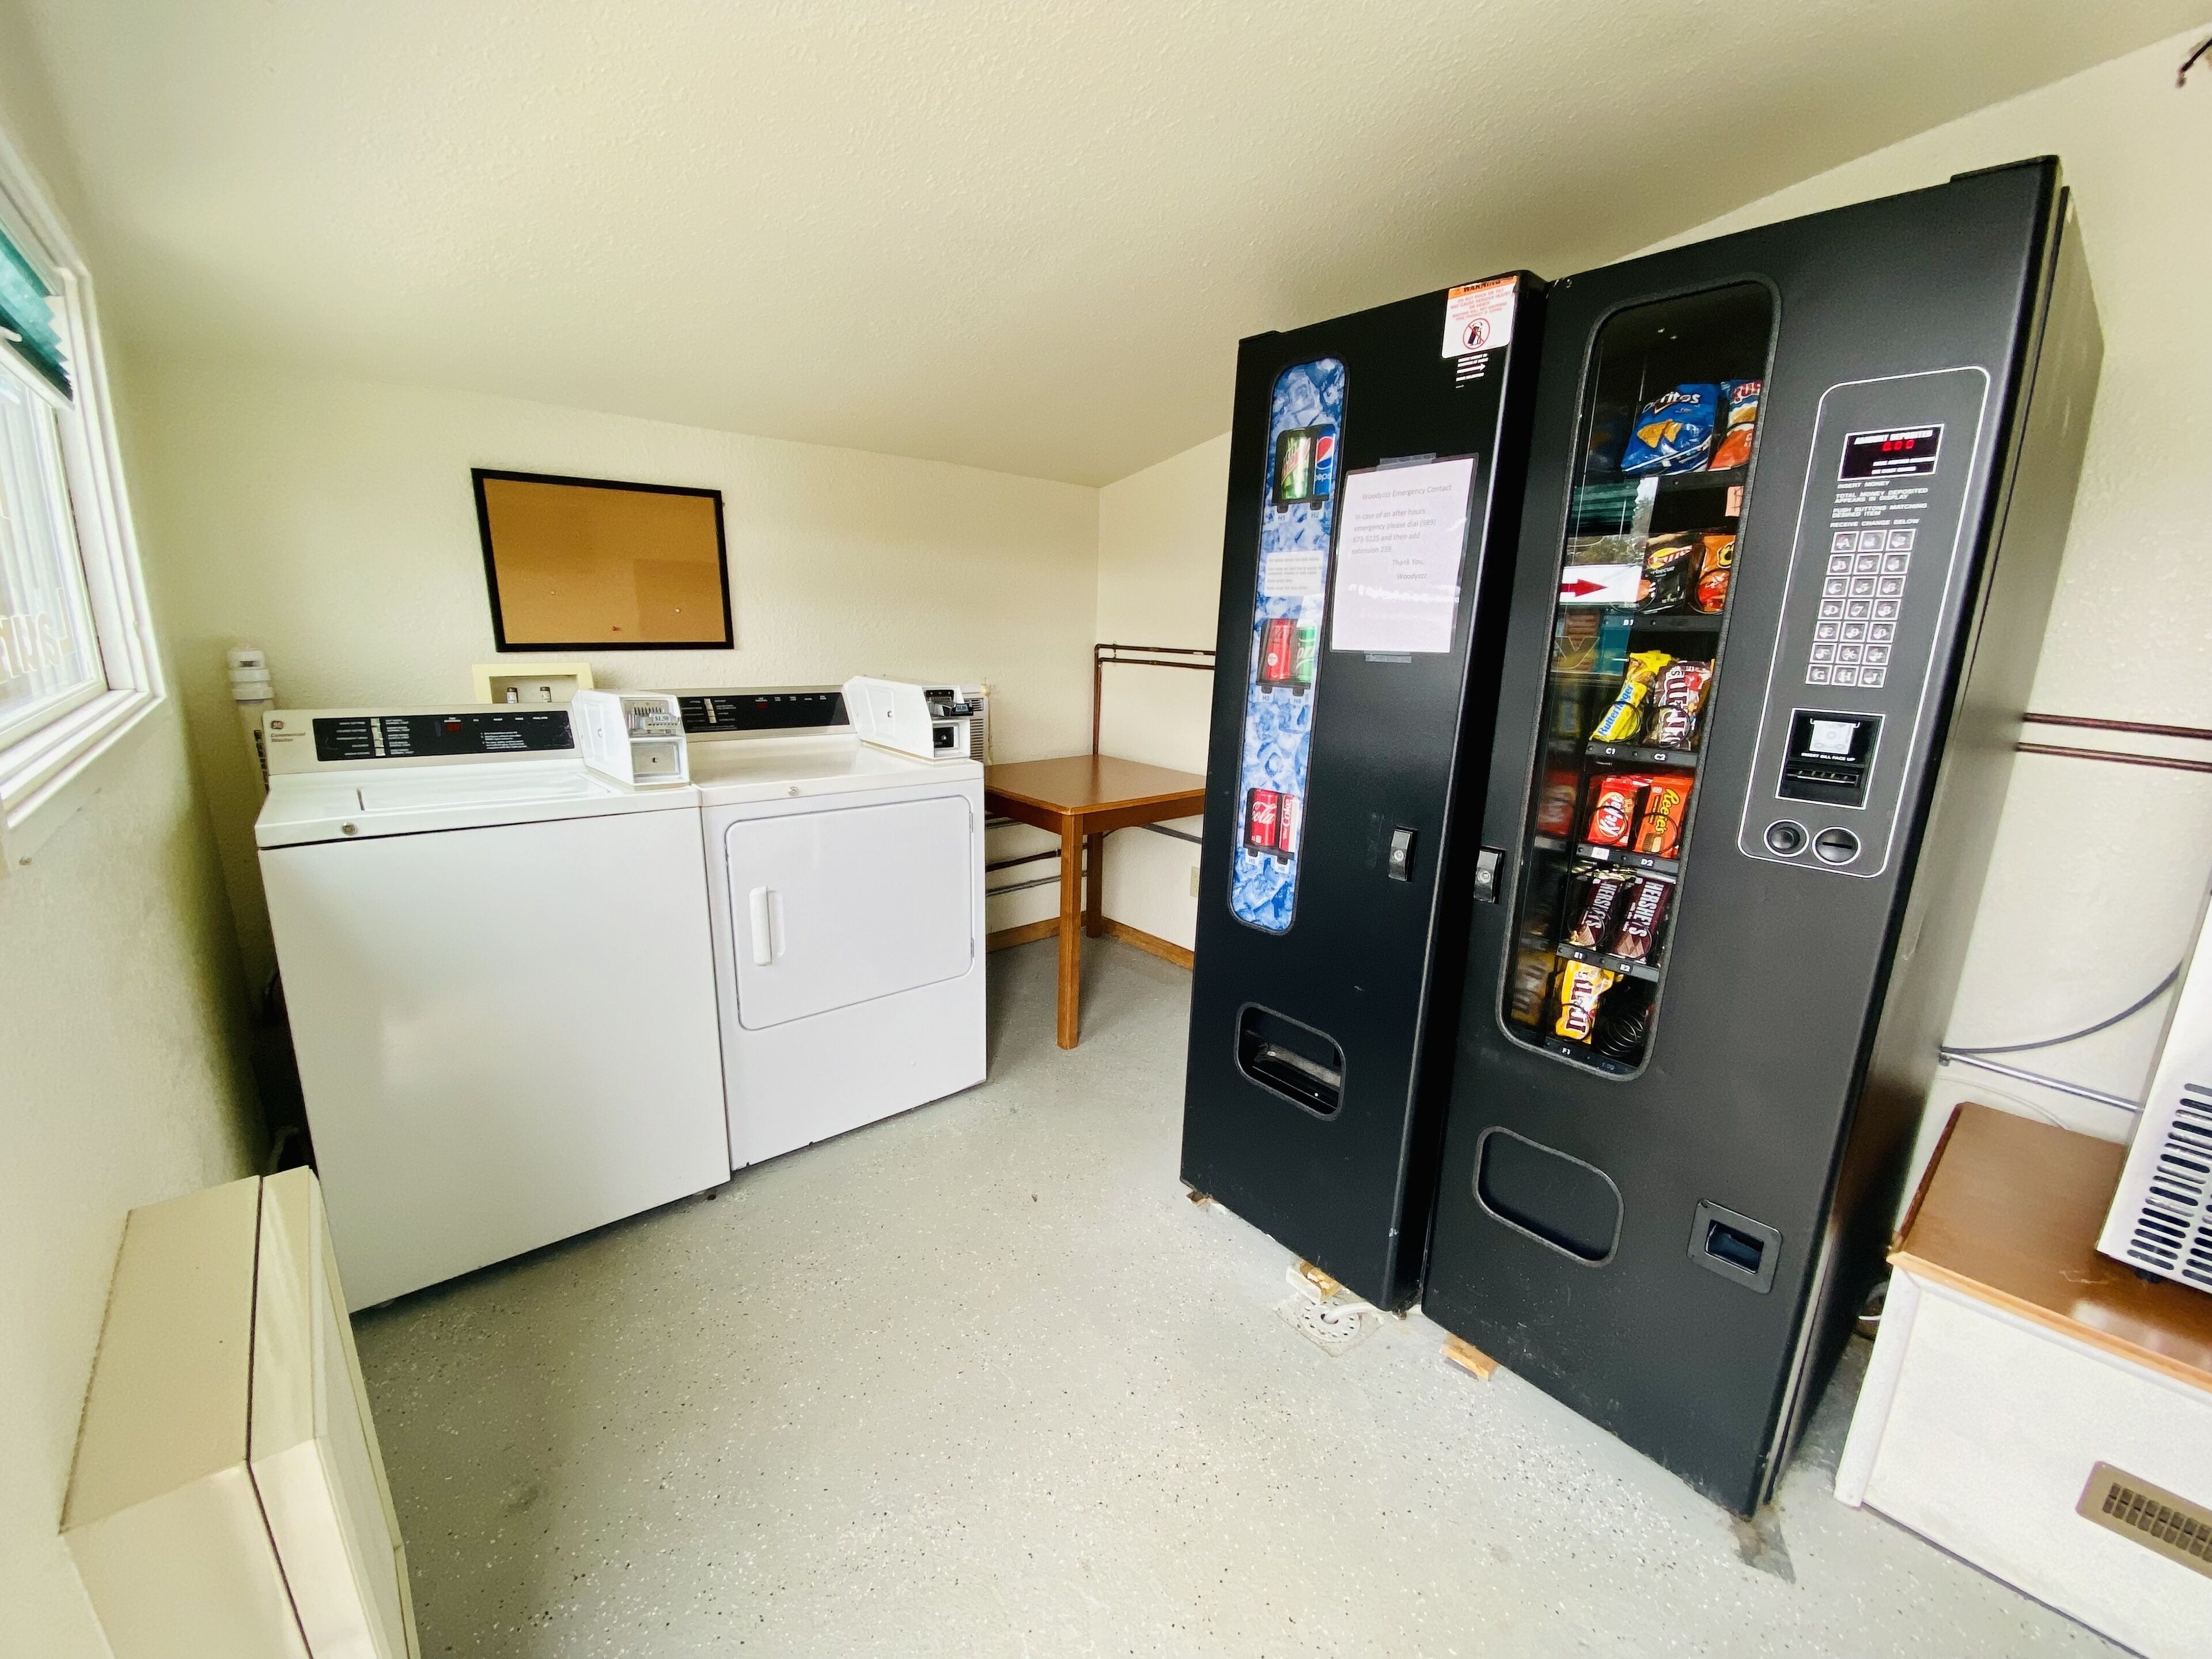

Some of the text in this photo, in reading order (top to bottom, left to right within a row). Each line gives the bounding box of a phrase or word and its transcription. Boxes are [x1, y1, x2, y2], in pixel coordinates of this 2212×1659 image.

[1463, 280, 1501, 293] WARNING
[1362, 484, 1452, 501] Woodyzzz Emergency Contact
[1888, 487, 1929, 495] DEPOSITED
[1889, 502, 1927, 510] MATCHING
[1376, 511, 1383, 519] of
[1392, 509, 1407, 517] after
[1408, 508, 1426, 516] hours
[1354, 518, 1437, 532] emergency please dial (989)
[1408, 531, 1421, 539] add
[1396, 571, 1427, 581] Woodyzzz
[1282, 798, 1291, 828] Coke
[1641, 858, 1653, 866] D2
[1628, 881, 1664, 938] HERSHEY'S
[1620, 964, 1631, 972] E2
